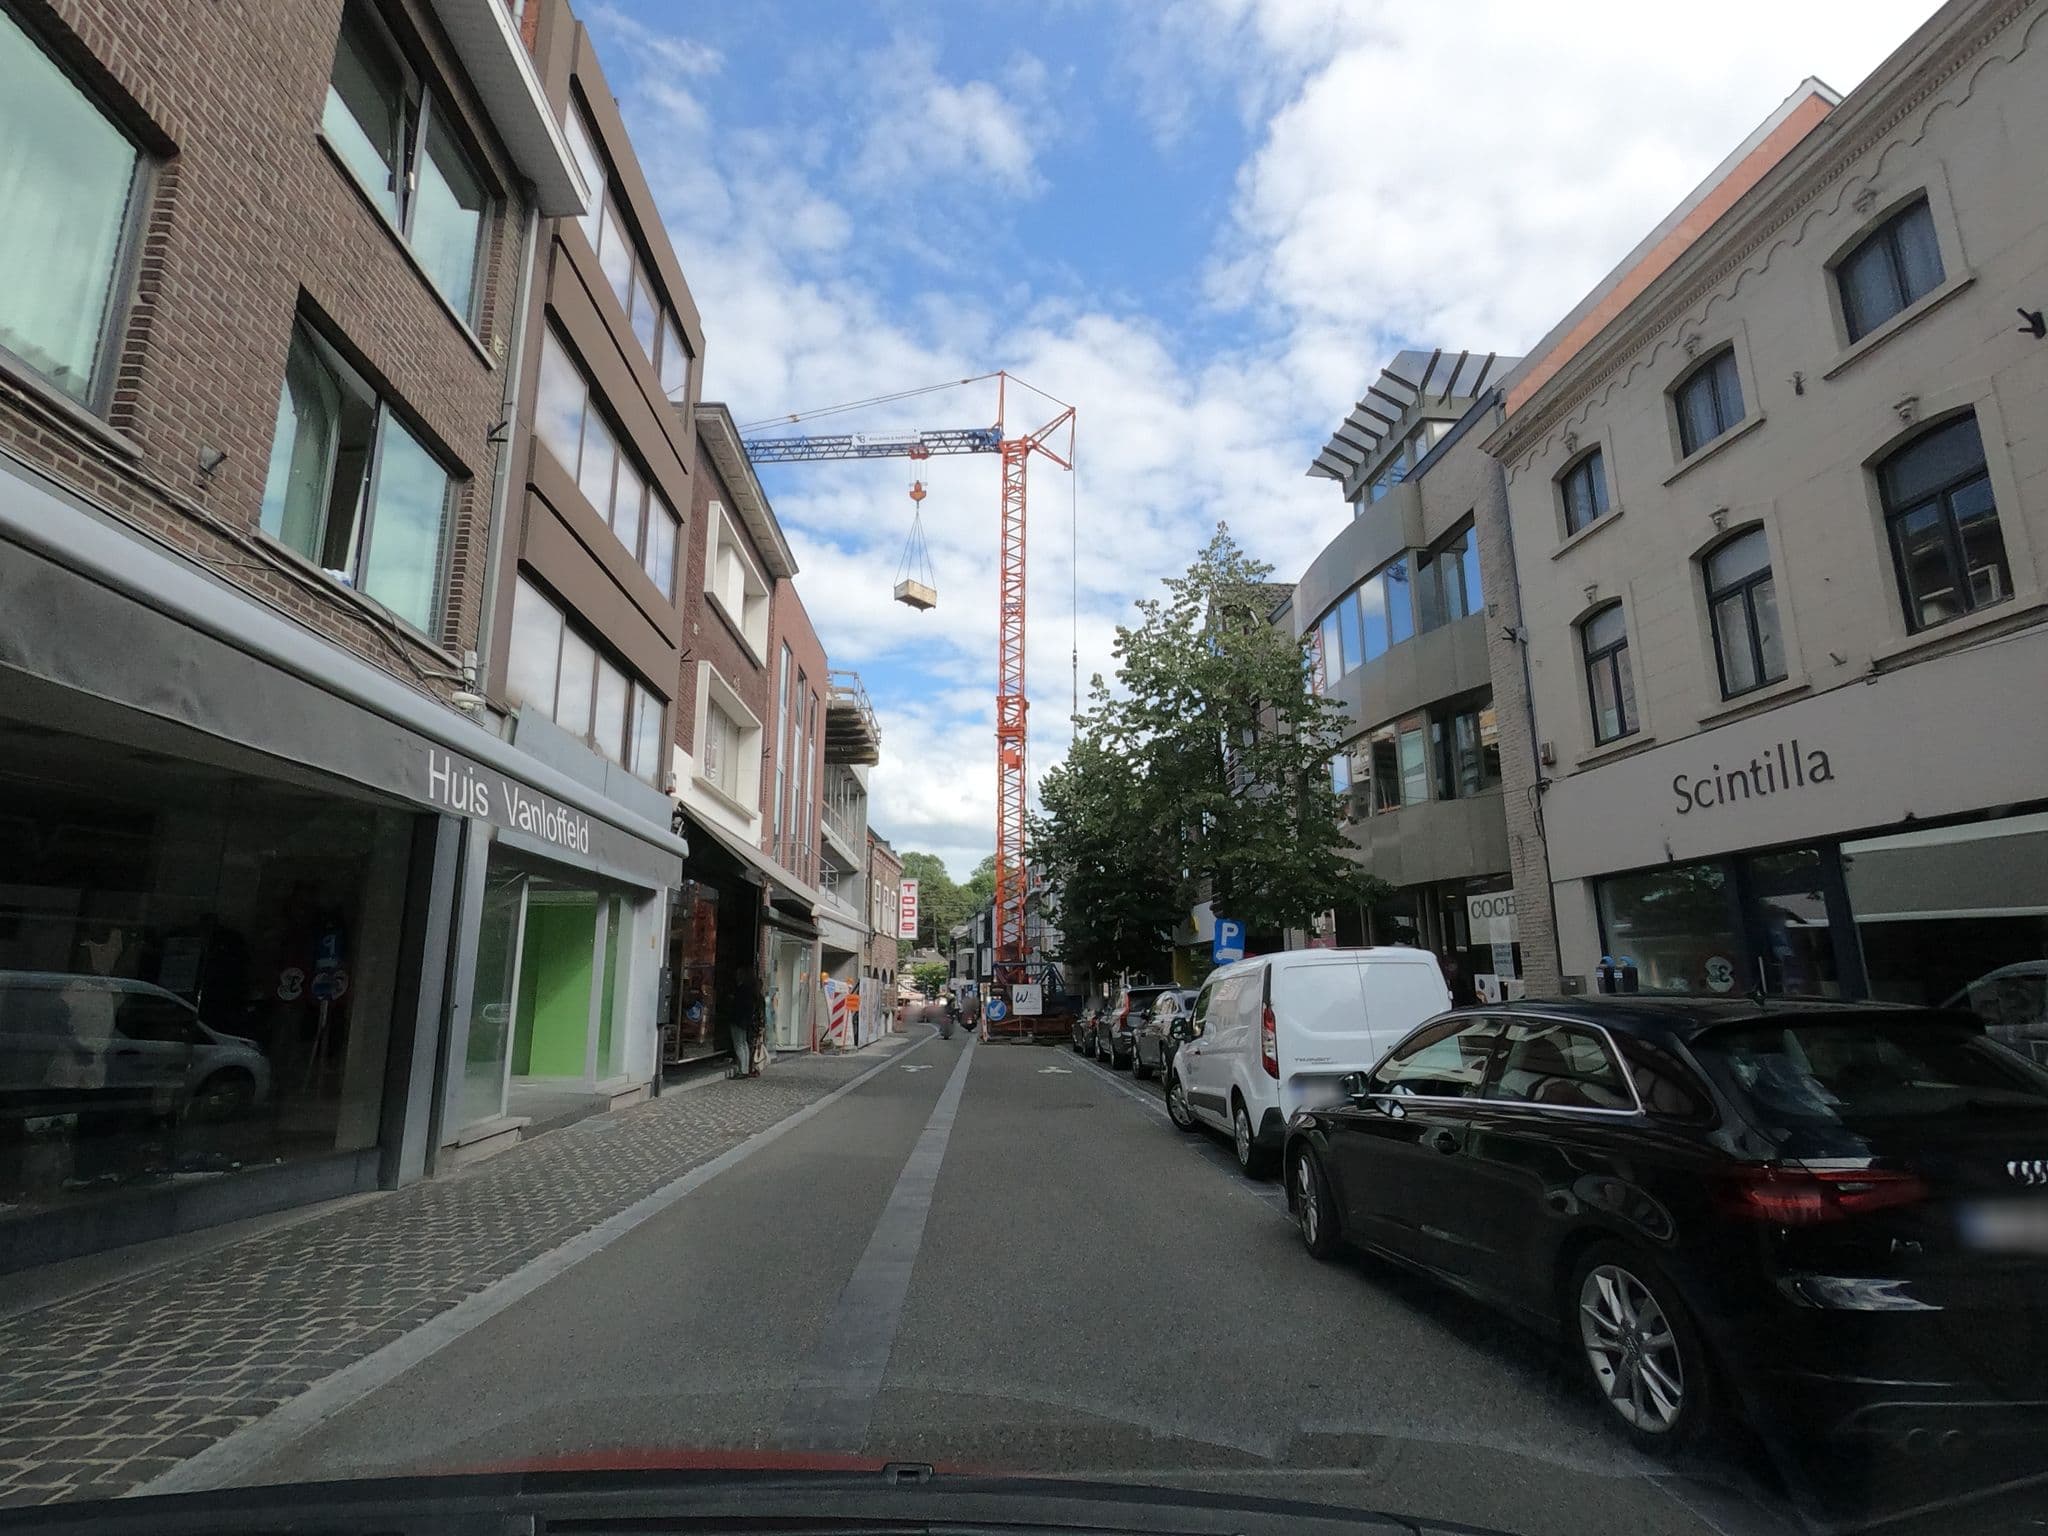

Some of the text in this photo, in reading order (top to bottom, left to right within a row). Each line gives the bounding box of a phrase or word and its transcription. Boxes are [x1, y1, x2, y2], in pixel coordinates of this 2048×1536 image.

[428, 749, 589, 854] Huis Vanloffeld
[1672, 739, 1835, 815] Scintilla
[901, 883, 915, 931] TOPS
[1221, 922, 1239, 946] P
